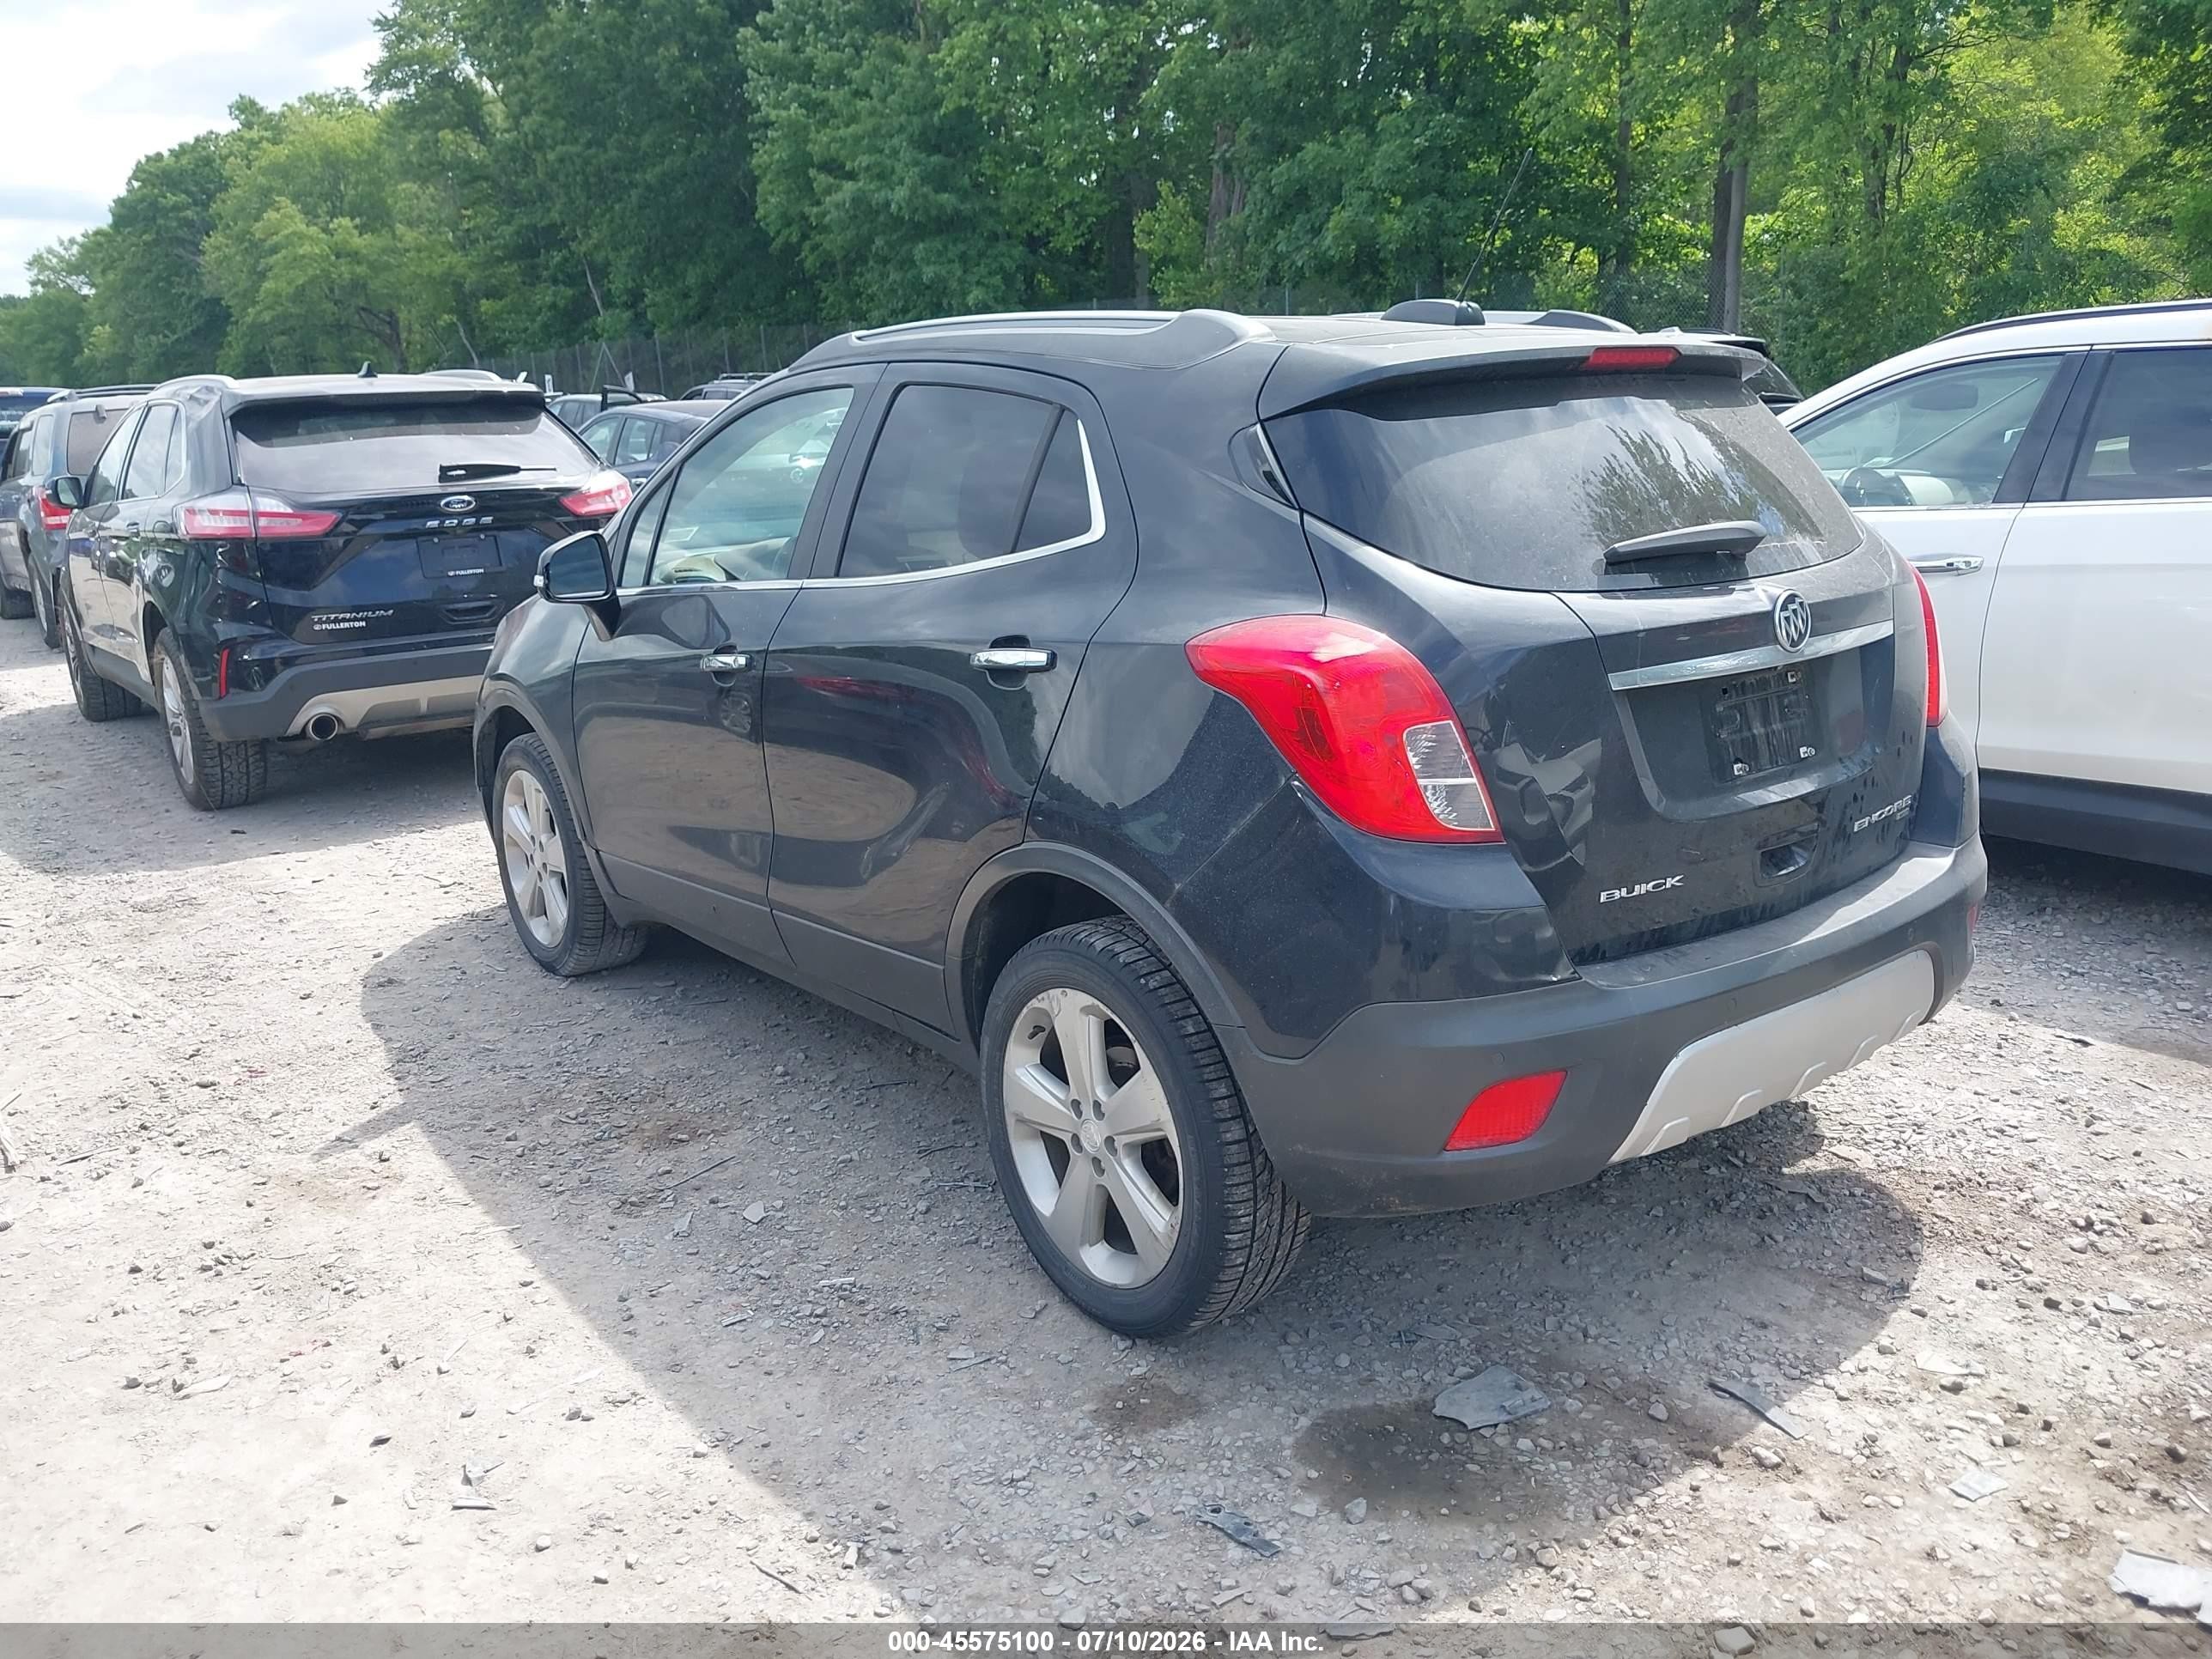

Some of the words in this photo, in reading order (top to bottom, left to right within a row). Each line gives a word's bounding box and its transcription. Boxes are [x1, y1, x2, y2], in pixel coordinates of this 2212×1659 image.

[311, 609, 394, 622] TITANIUM
[322, 621, 366, 630] FULLERTON
[1853, 794, 1912, 832] ENCORE
[1600, 874, 1684, 903] BUICK
